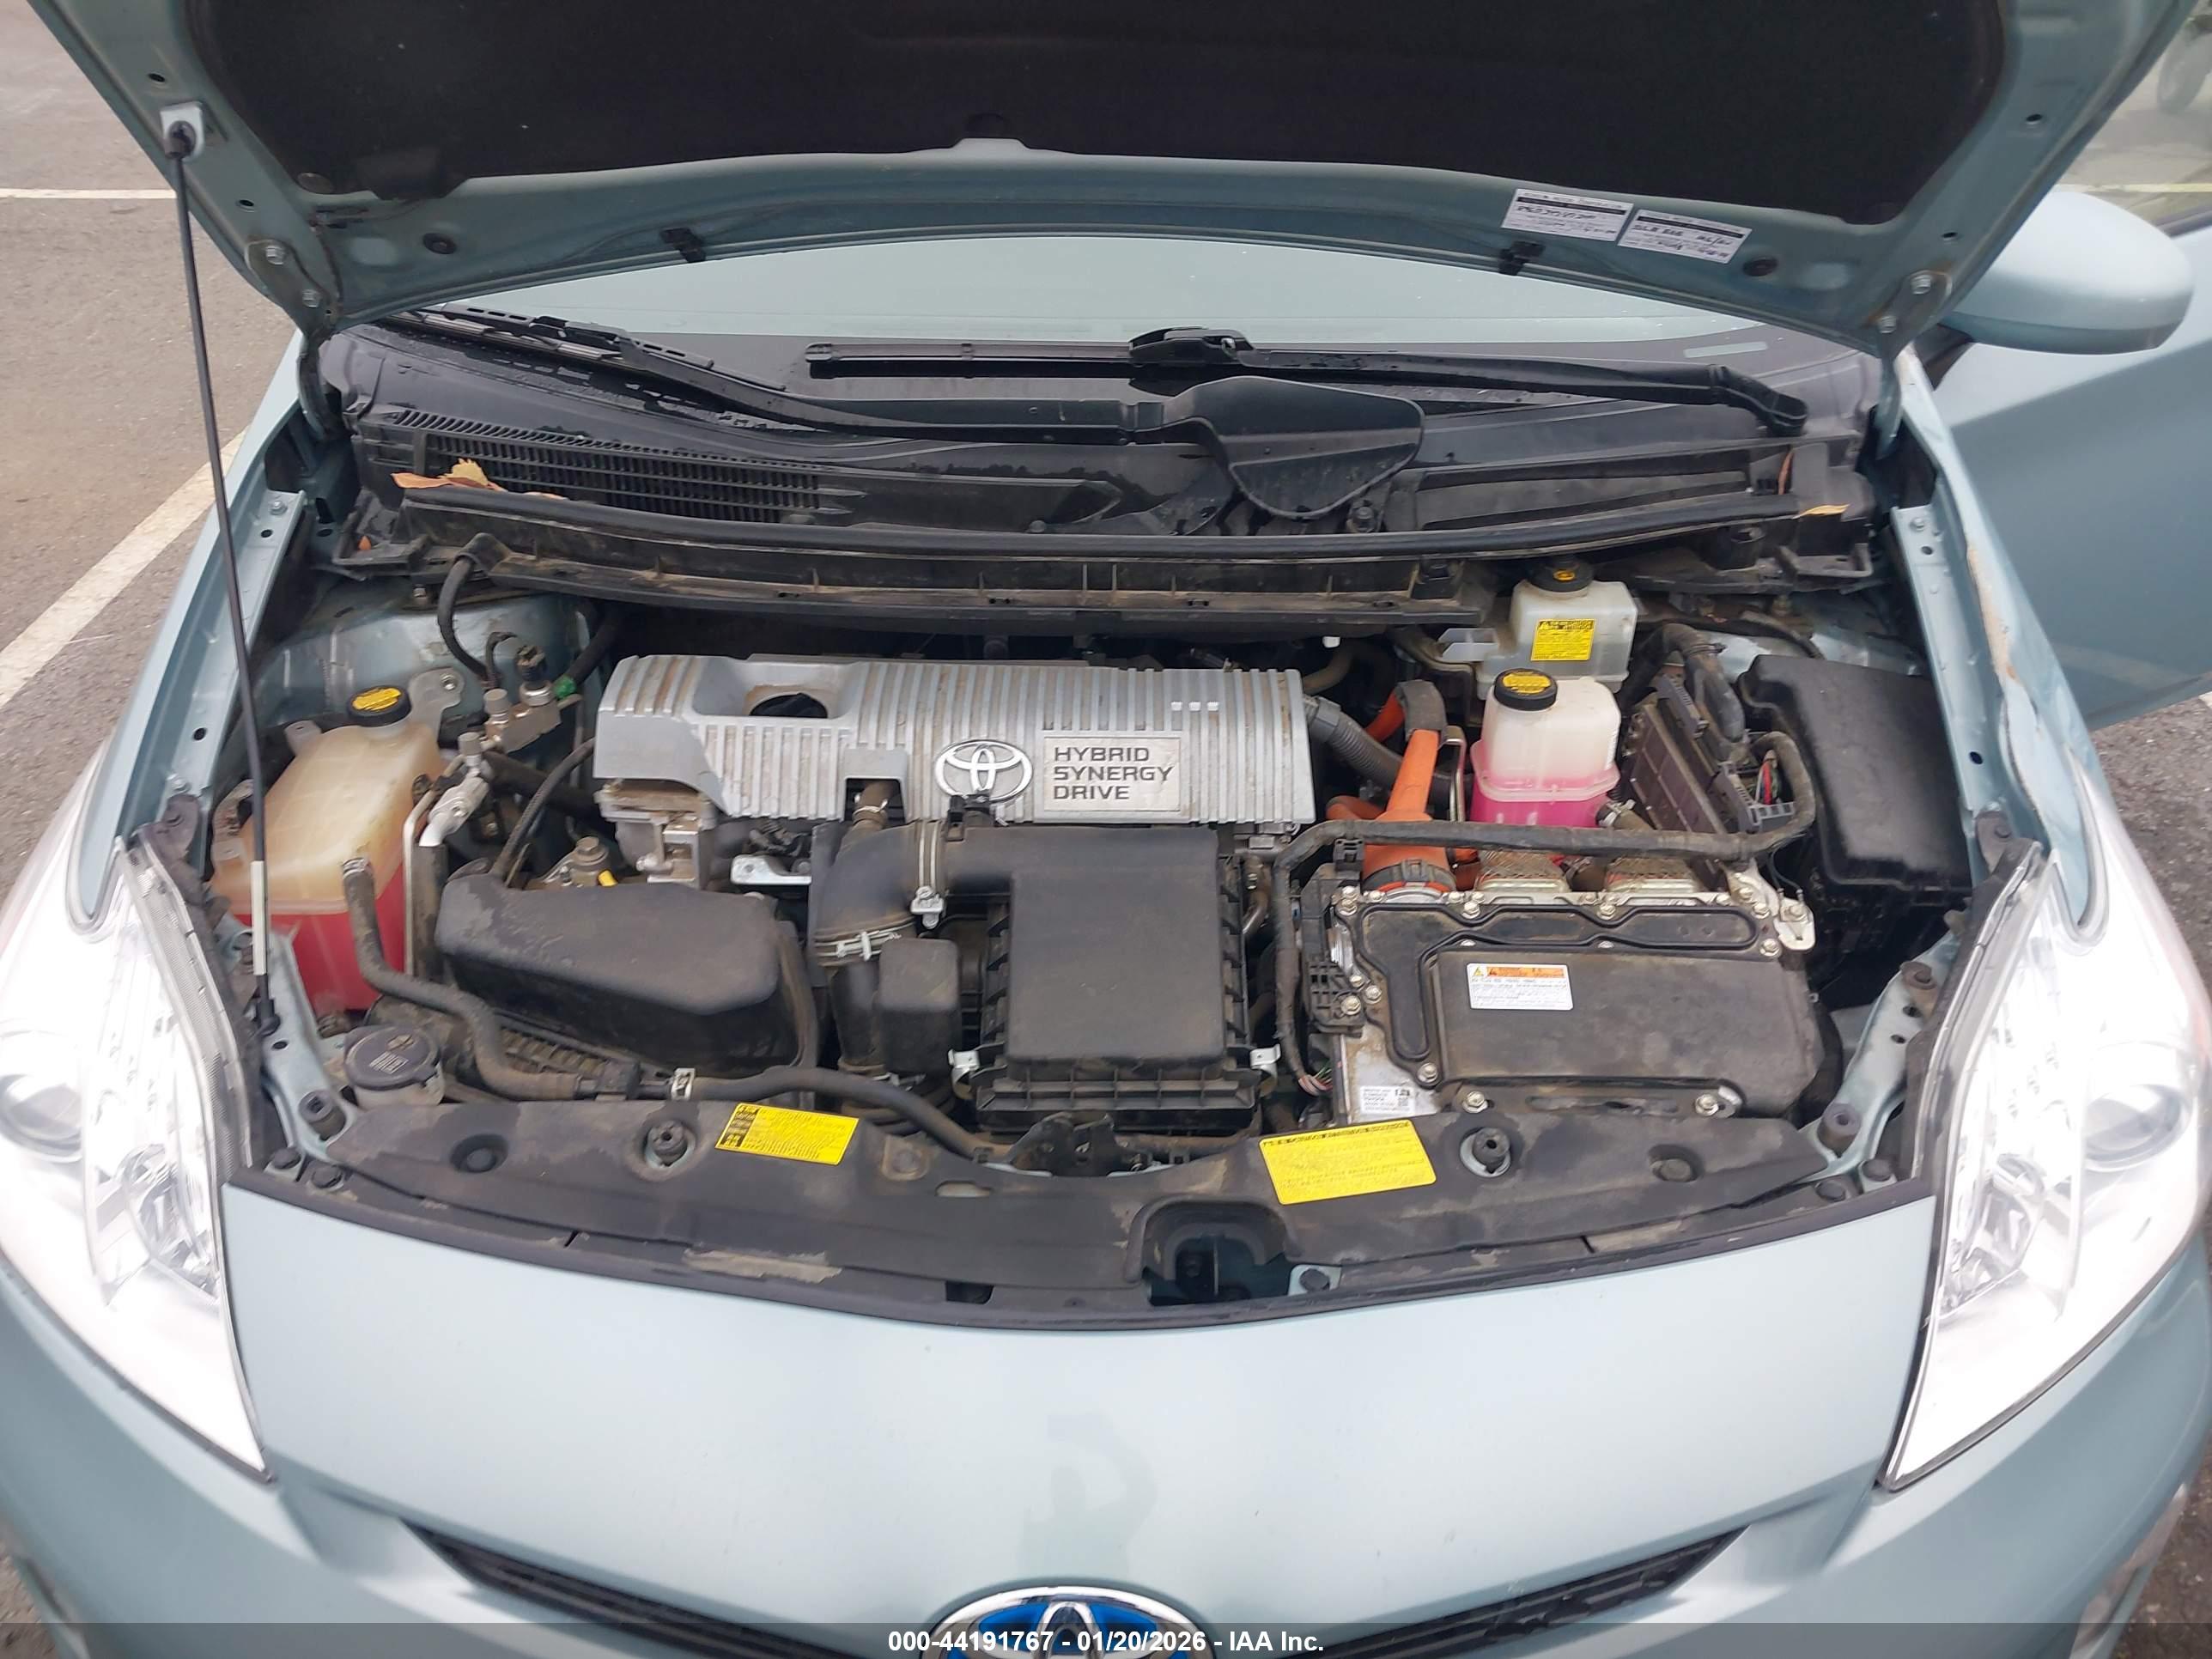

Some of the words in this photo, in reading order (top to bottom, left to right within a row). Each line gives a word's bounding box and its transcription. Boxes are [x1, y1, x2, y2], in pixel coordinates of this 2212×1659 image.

[1054, 747, 1150, 762] HYBRID
[1054, 766, 1174, 781] SYNERGY
[1054, 786, 1130, 799] DRIVE
